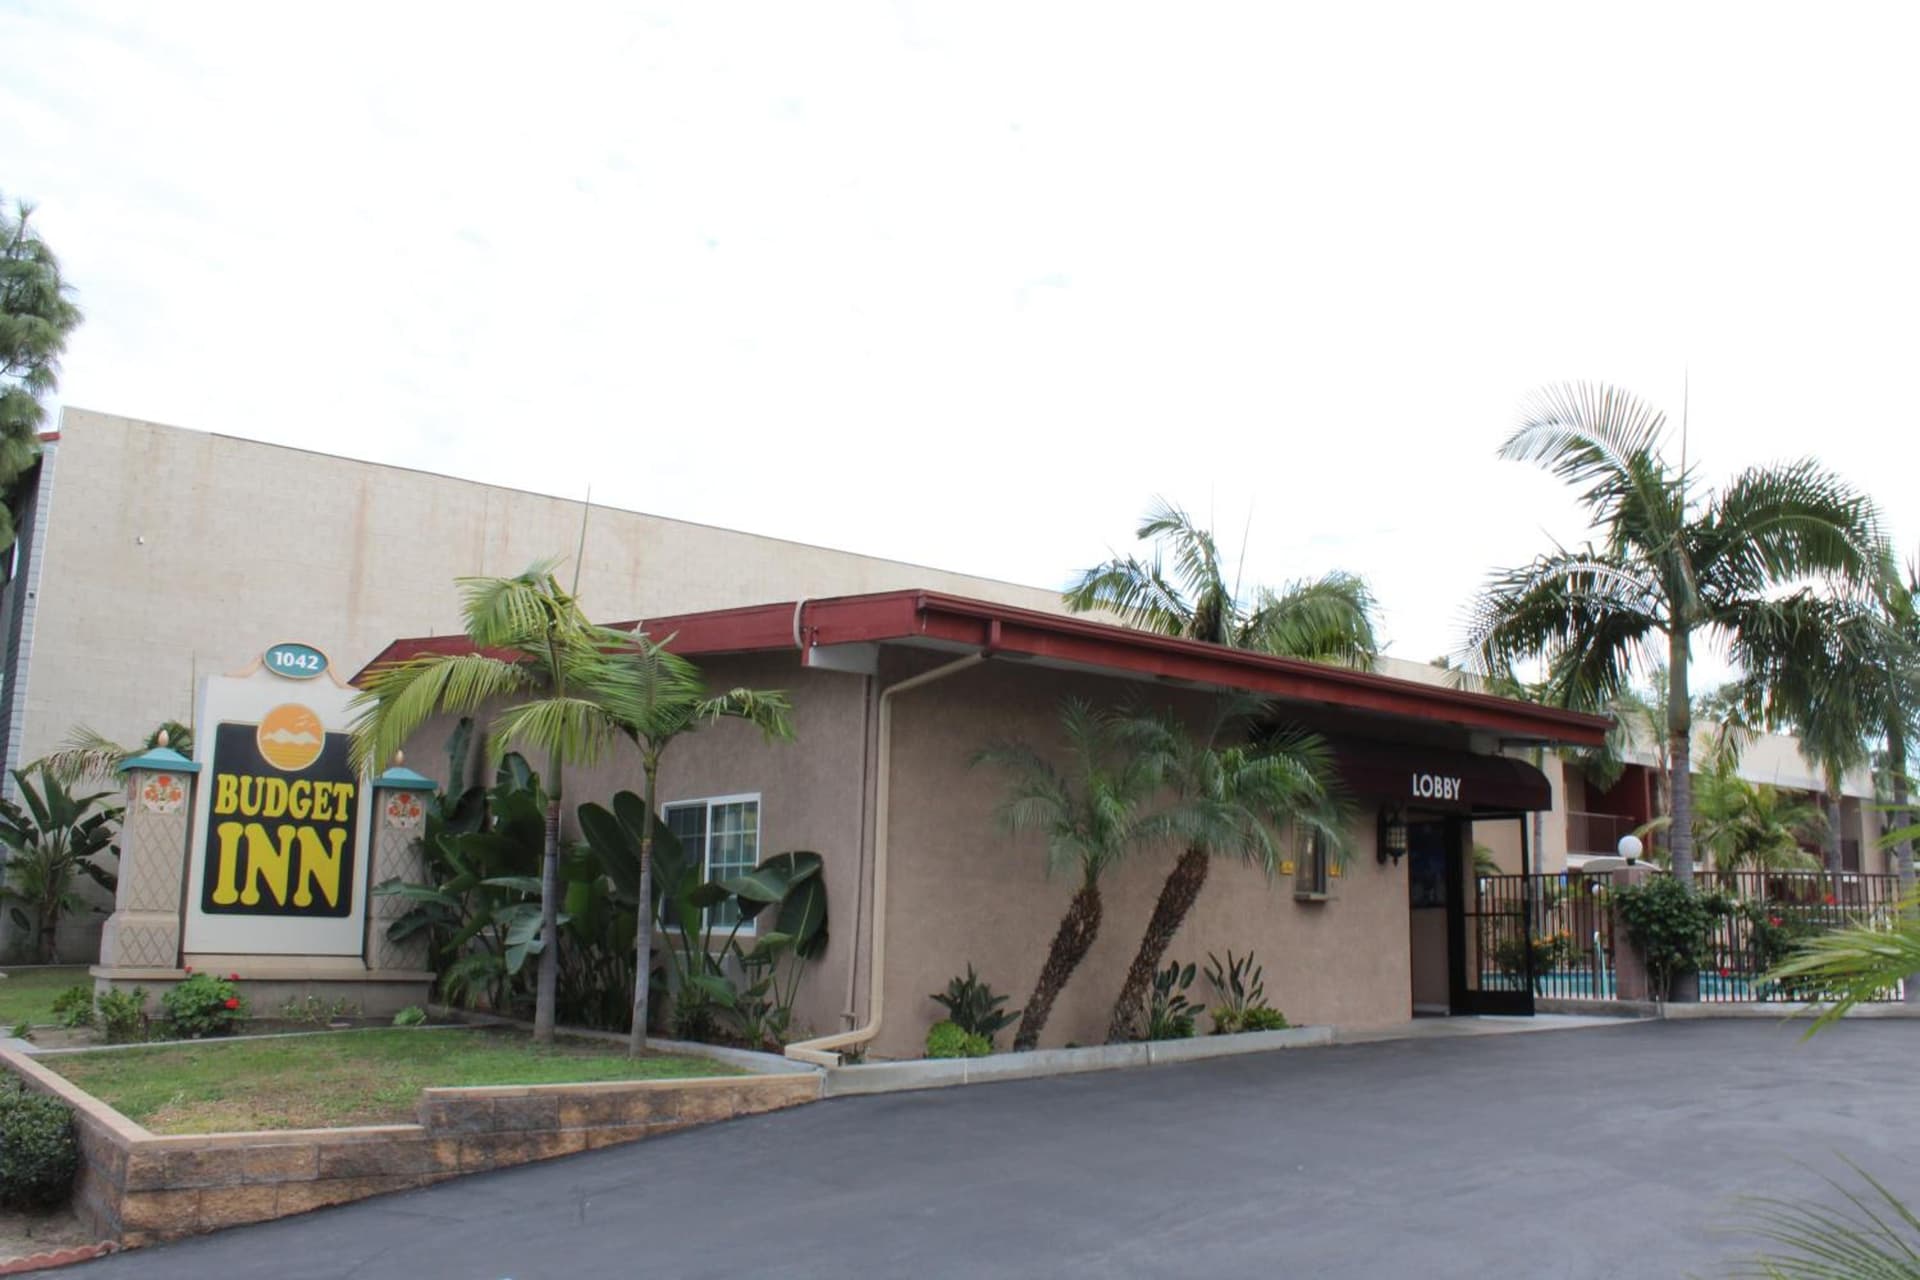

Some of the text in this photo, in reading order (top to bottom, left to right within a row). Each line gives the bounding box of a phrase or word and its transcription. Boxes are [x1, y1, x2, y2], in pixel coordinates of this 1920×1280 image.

[275, 650, 319, 670] 1042
[214, 773, 354, 822] BUDGET
[1412, 773, 1462, 800] LOBBY
[212, 822, 347, 907] INN
